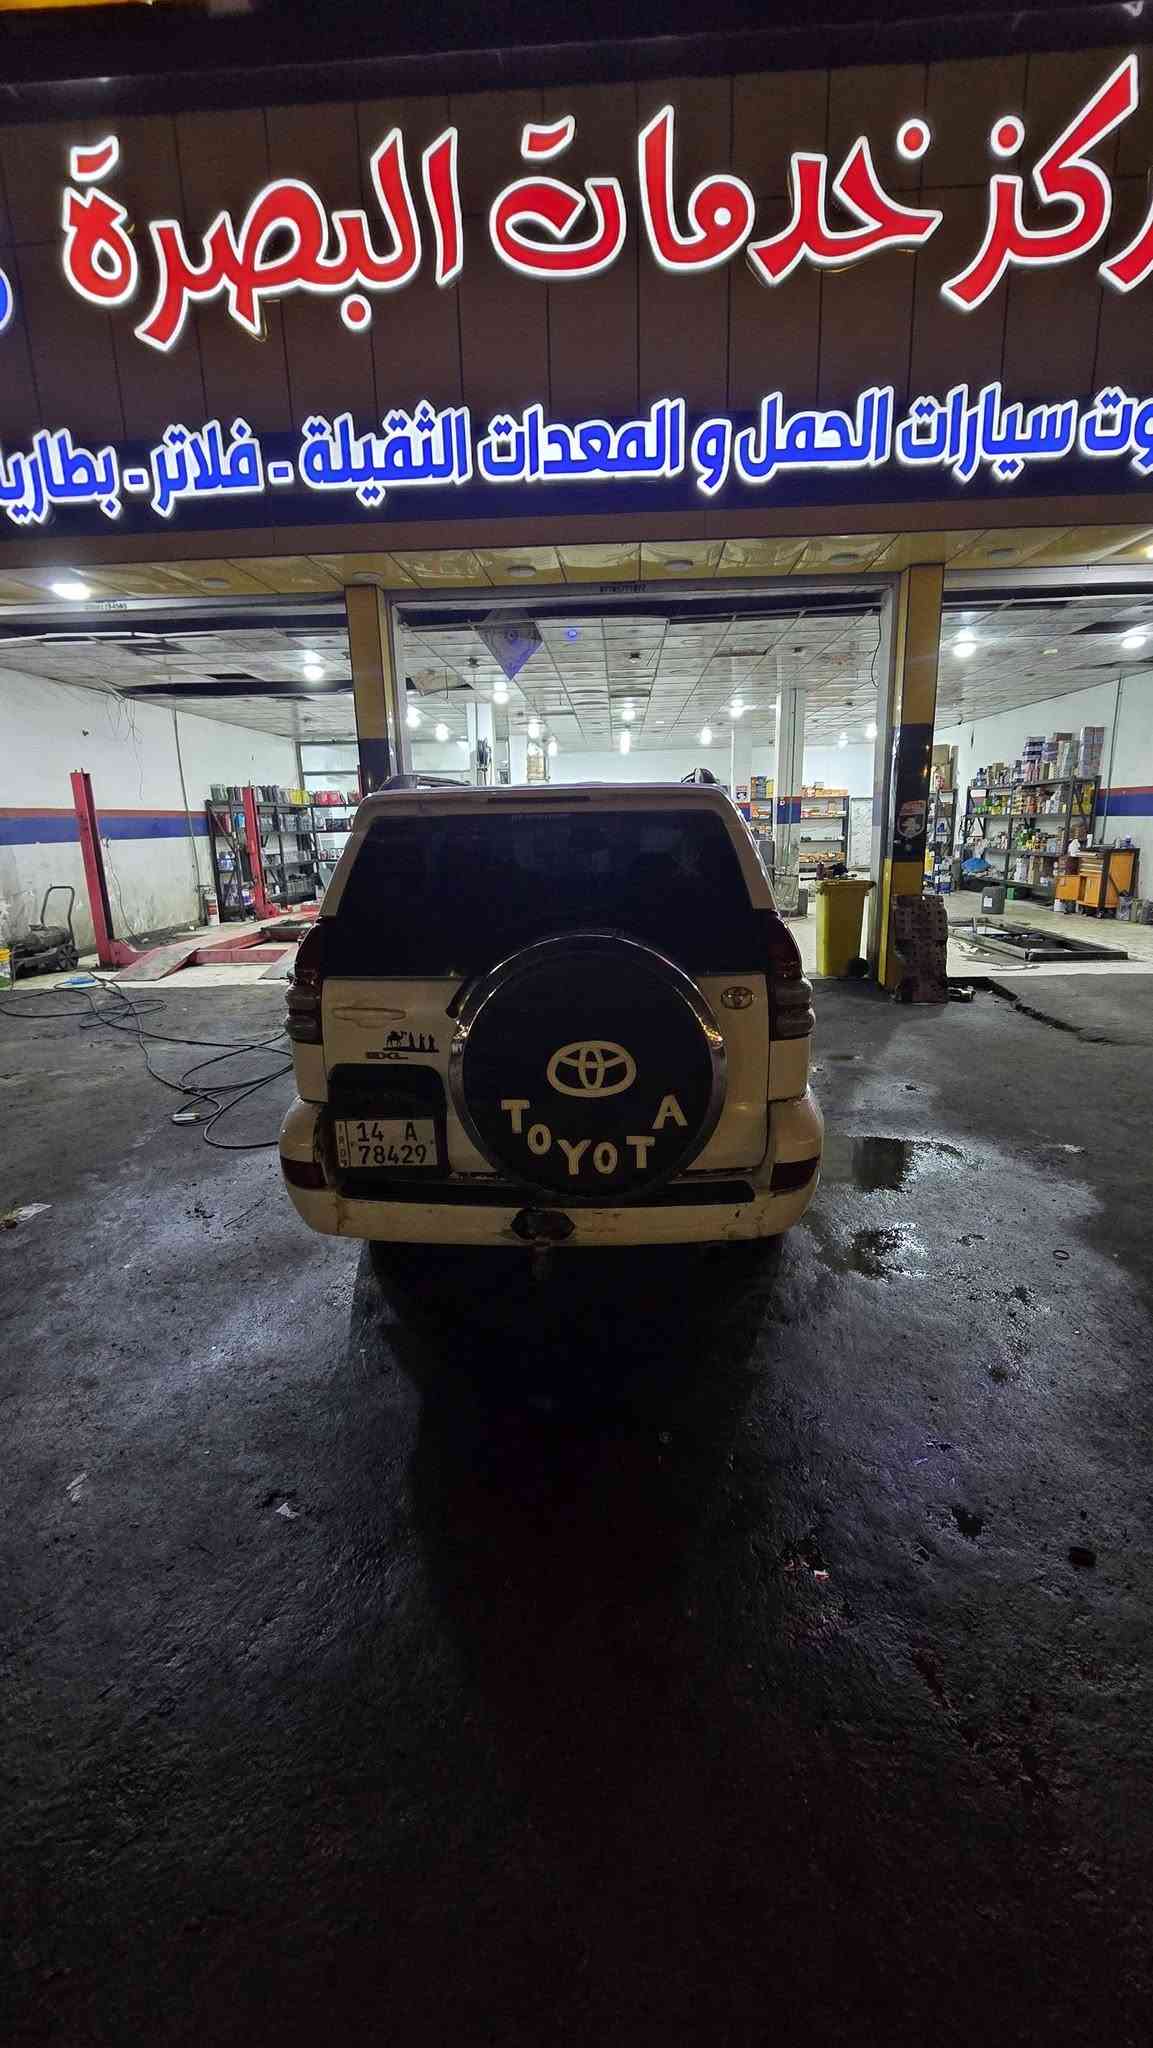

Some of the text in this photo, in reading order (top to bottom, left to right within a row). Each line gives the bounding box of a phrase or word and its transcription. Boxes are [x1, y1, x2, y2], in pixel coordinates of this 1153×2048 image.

[62, 54, 1153, 352] ركز خدمات البصرة
[0, 428, 121, 524] بطاري
[150, 418, 264, 517] فلاتر
[299, 400, 473, 507] الثقيلة
[477, 398, 685, 483] المعدات
[691, 418, 732, 496] و
[734, 386, 894, 484] الحمل
[896, 382, 1078, 482] سيارات
[1078, 386, 1153, 474] وت
[356, 1121, 418, 1142] 14 A
[358, 1144, 427, 1165] 78429
[501, 1094, 688, 1176] TOYOTA
